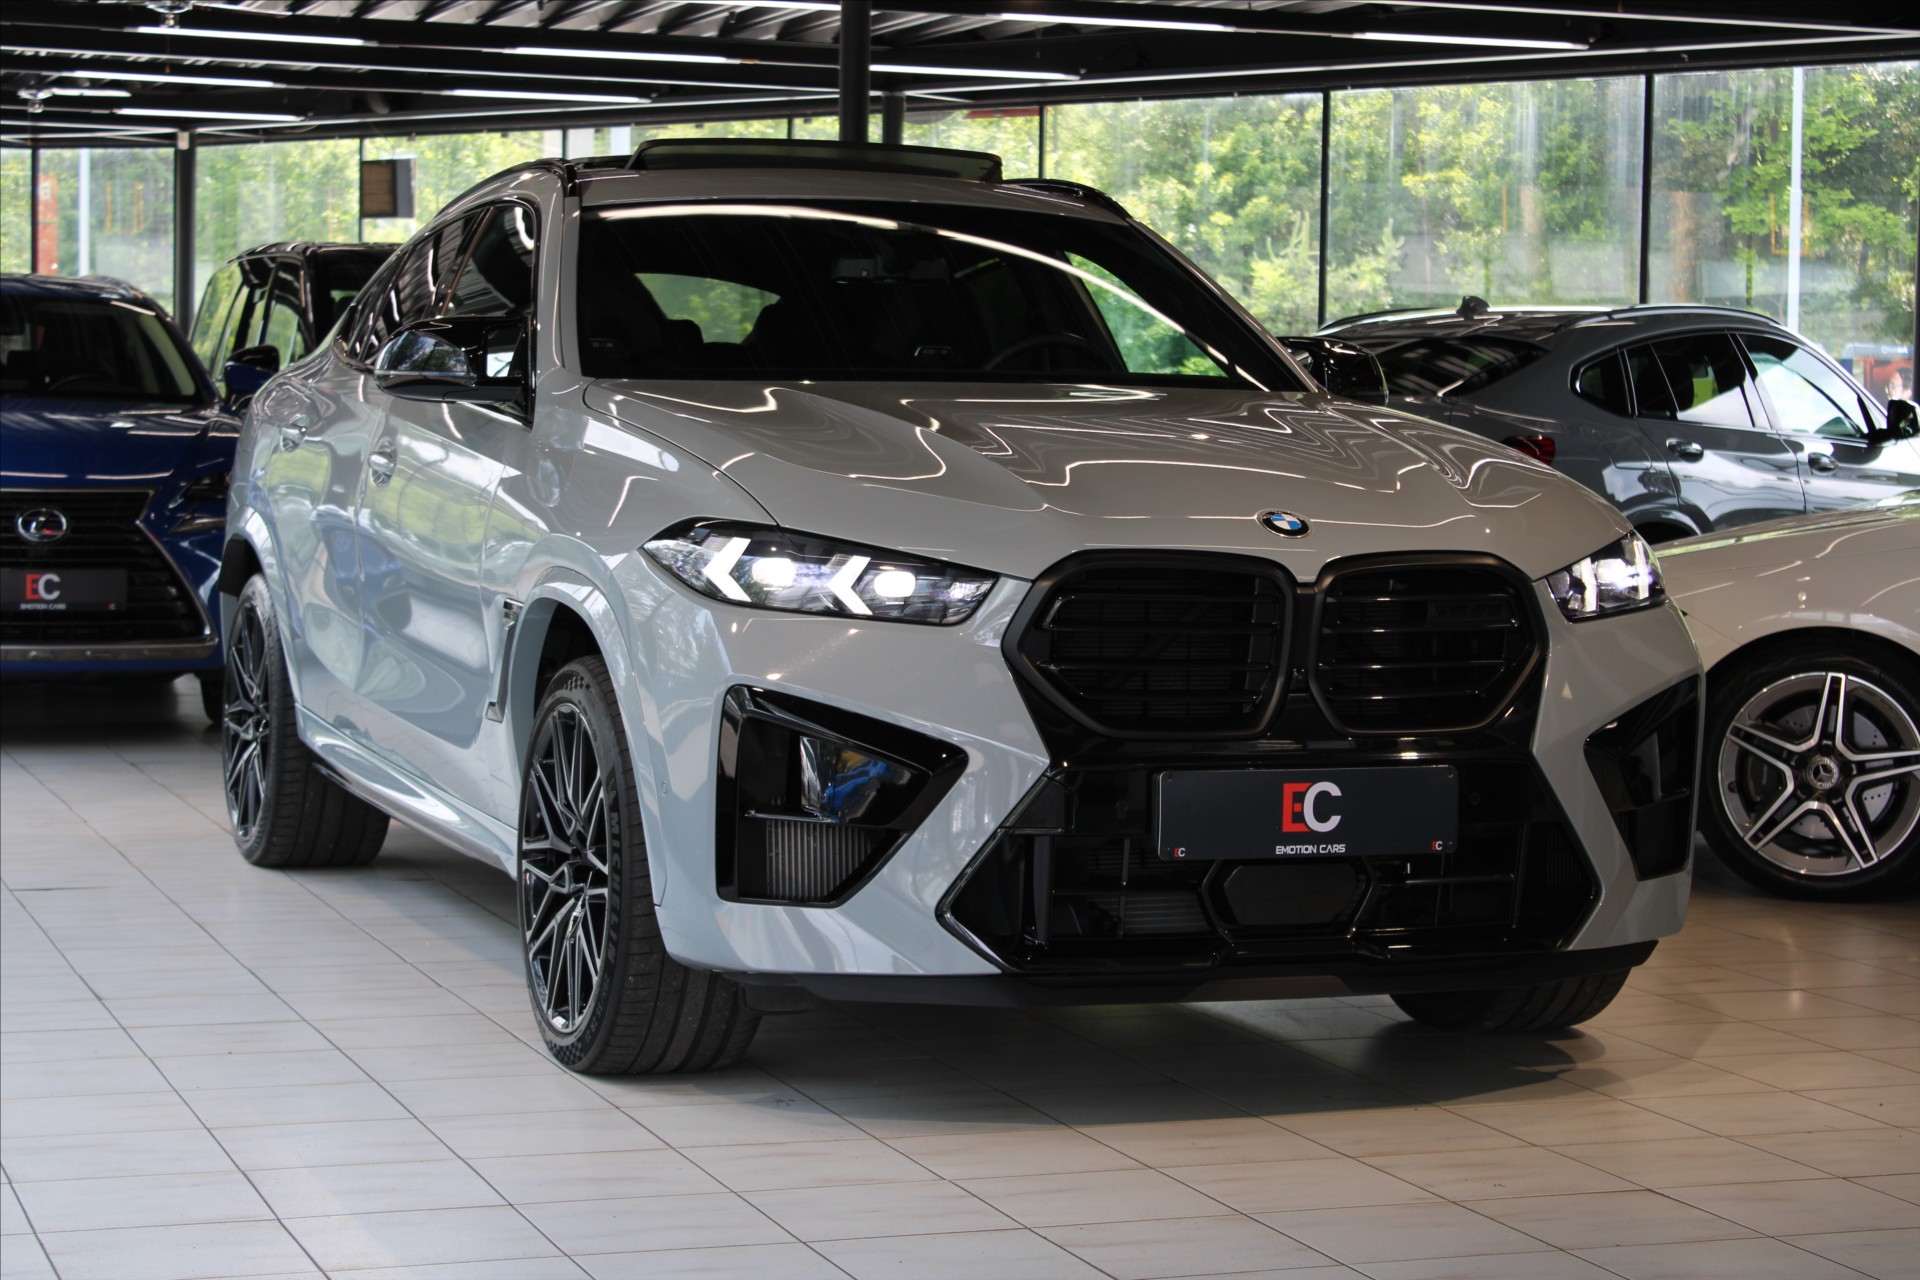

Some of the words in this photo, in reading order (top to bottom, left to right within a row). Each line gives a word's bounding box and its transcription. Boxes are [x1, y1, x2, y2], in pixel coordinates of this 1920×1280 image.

[25, 573, 61, 600] EC
[1282, 781, 1342, 832] EC
[1173, 847, 1186, 857] EC
[1275, 845, 1317, 854] EMOTION
[1319, 844, 1346, 853] CARS
[1431, 840, 1443, 850] EC
[607, 811, 622, 964] MICHELIN
